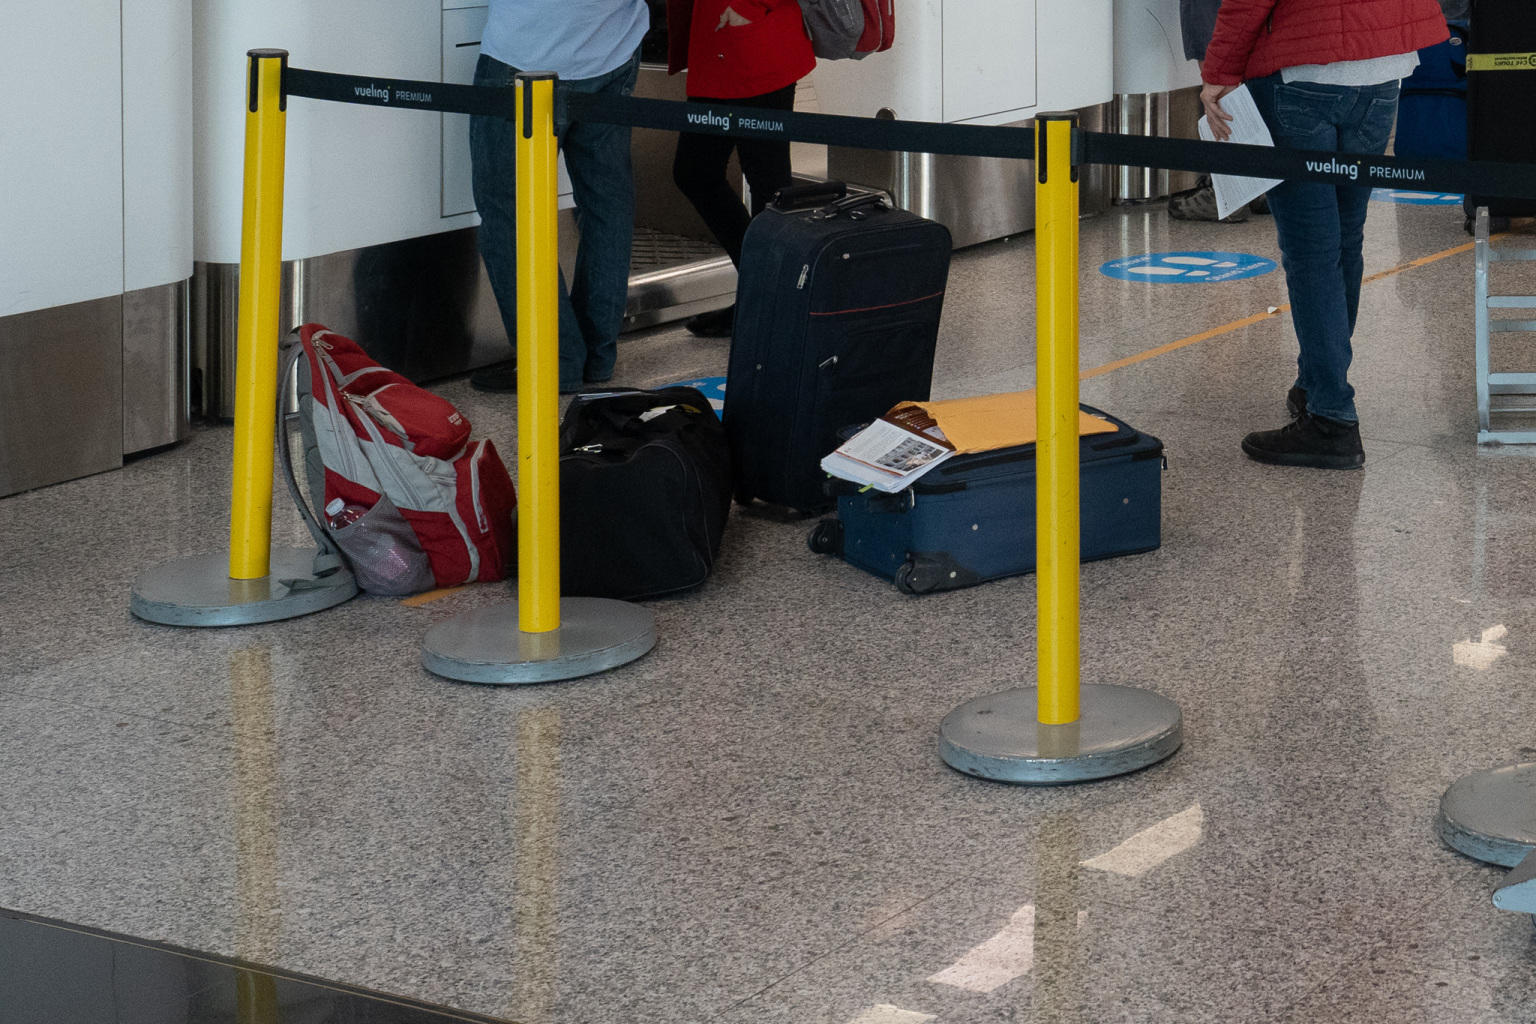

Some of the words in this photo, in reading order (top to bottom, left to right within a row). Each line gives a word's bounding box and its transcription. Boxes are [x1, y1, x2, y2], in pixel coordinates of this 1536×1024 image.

[354, 85, 390, 103] vueling
[395, 90, 432, 103] PREMIUM
[687, 110, 730, 131] vueling
[738, 118, 784, 132] PREMIUM
[1306, 157, 1359, 180] vueling
[1369, 166, 1425, 181] PREMIUM
